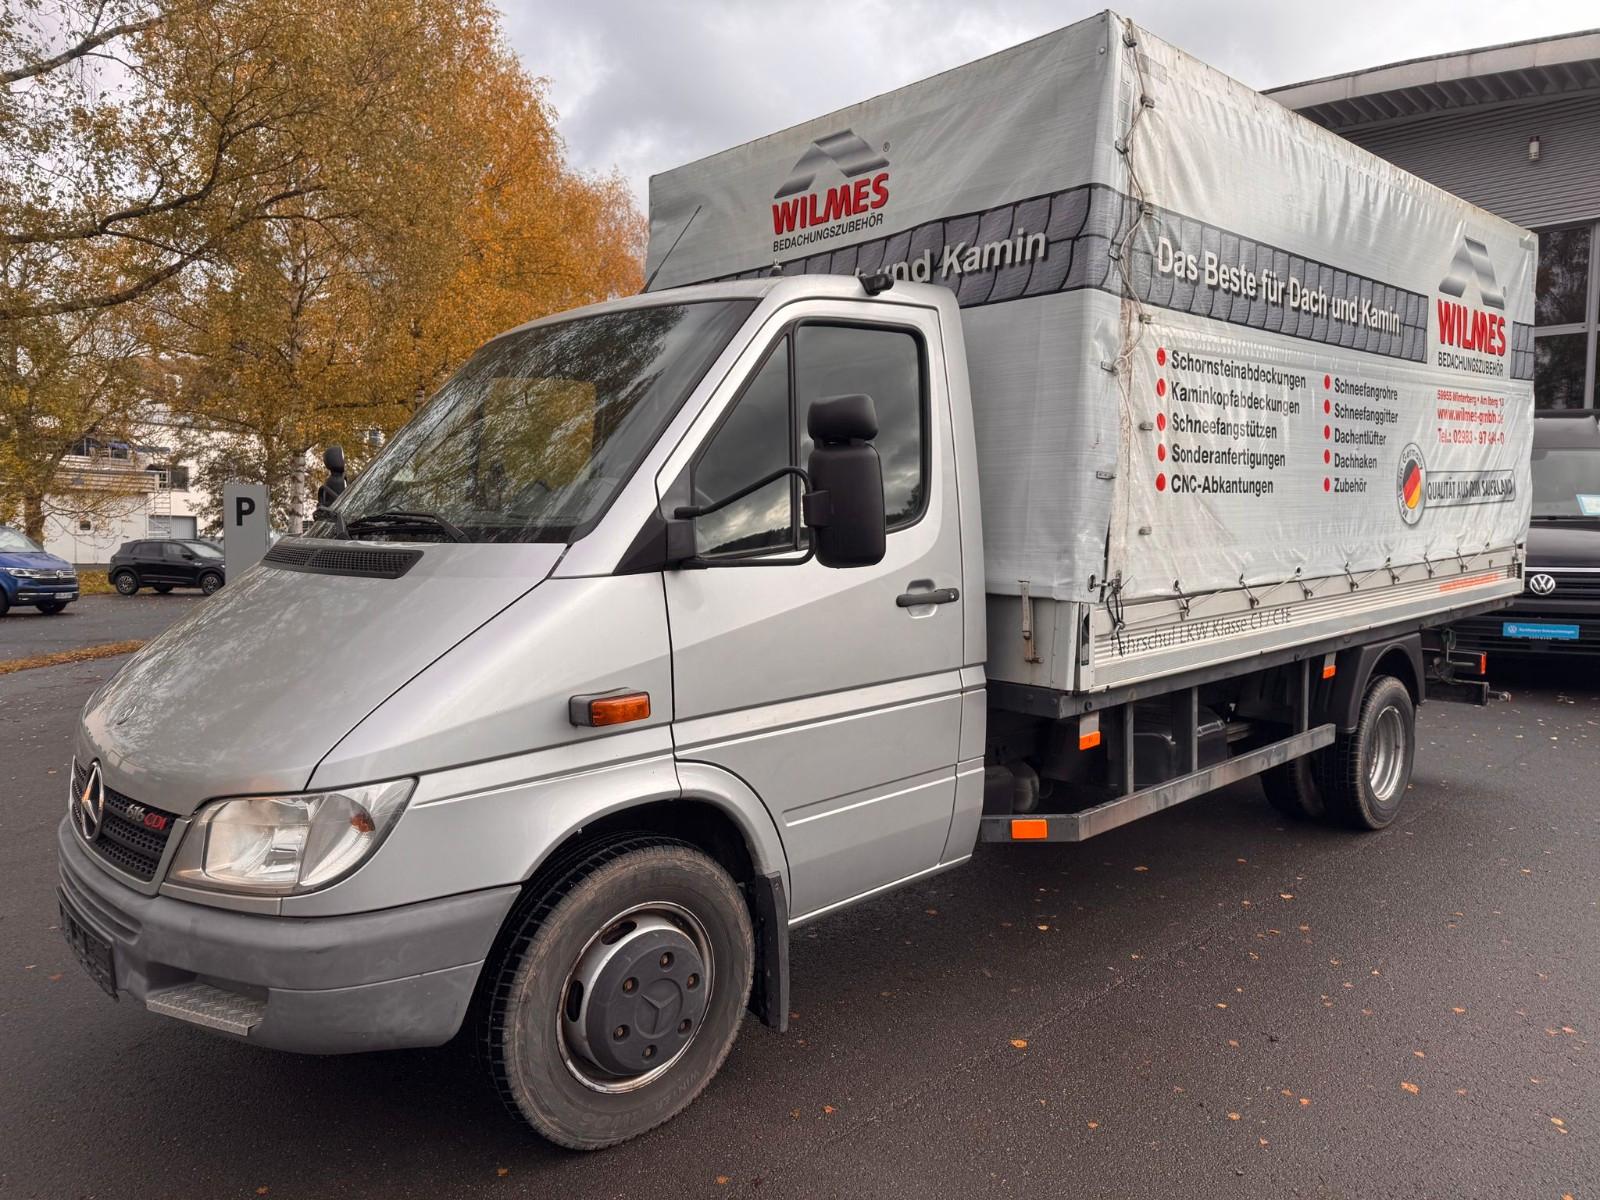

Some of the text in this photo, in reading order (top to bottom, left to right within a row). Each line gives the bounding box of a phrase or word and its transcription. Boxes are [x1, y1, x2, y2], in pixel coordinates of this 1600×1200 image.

[772, 173, 889, 235] WILMES
[773, 212, 884, 252] BEDACHUNGSZUBEHÖR
[941, 227, 1047, 278] Kamin
[1158, 236, 1400, 333] Das Beste für Dach und Kamin
[1437, 299, 1506, 357] WILMES
[1171, 350, 1306, 390] Schornsteinabdeckungen
[1438, 351, 1504, 377] BEDACHUNGSZUBEHÖR
[1171, 381, 1300, 416] Kaminkopfabdeckungen
[1334, 378, 1398, 401] Schneefangrohre
[1172, 413, 1277, 440] Schneefangstützen
[1334, 402, 1398, 425] Schneefanggitter
[1334, 428, 1387, 446] Dachentlüfter
[1171, 443, 1286, 469] Sonderanfertigungen
[1334, 453, 1378, 469] Dachhaken
[1171, 474, 1273, 497] CNC-Abkantungen
[1334, 477, 1368, 493] Zubehör
[1427, 477, 1456, 500] QUALITÄT
[236, 496, 256, 527] P
[1180, 622, 1209, 643] LKW
[1212, 617, 1248, 638] Klasse
[144, 812, 168, 831] CDI
